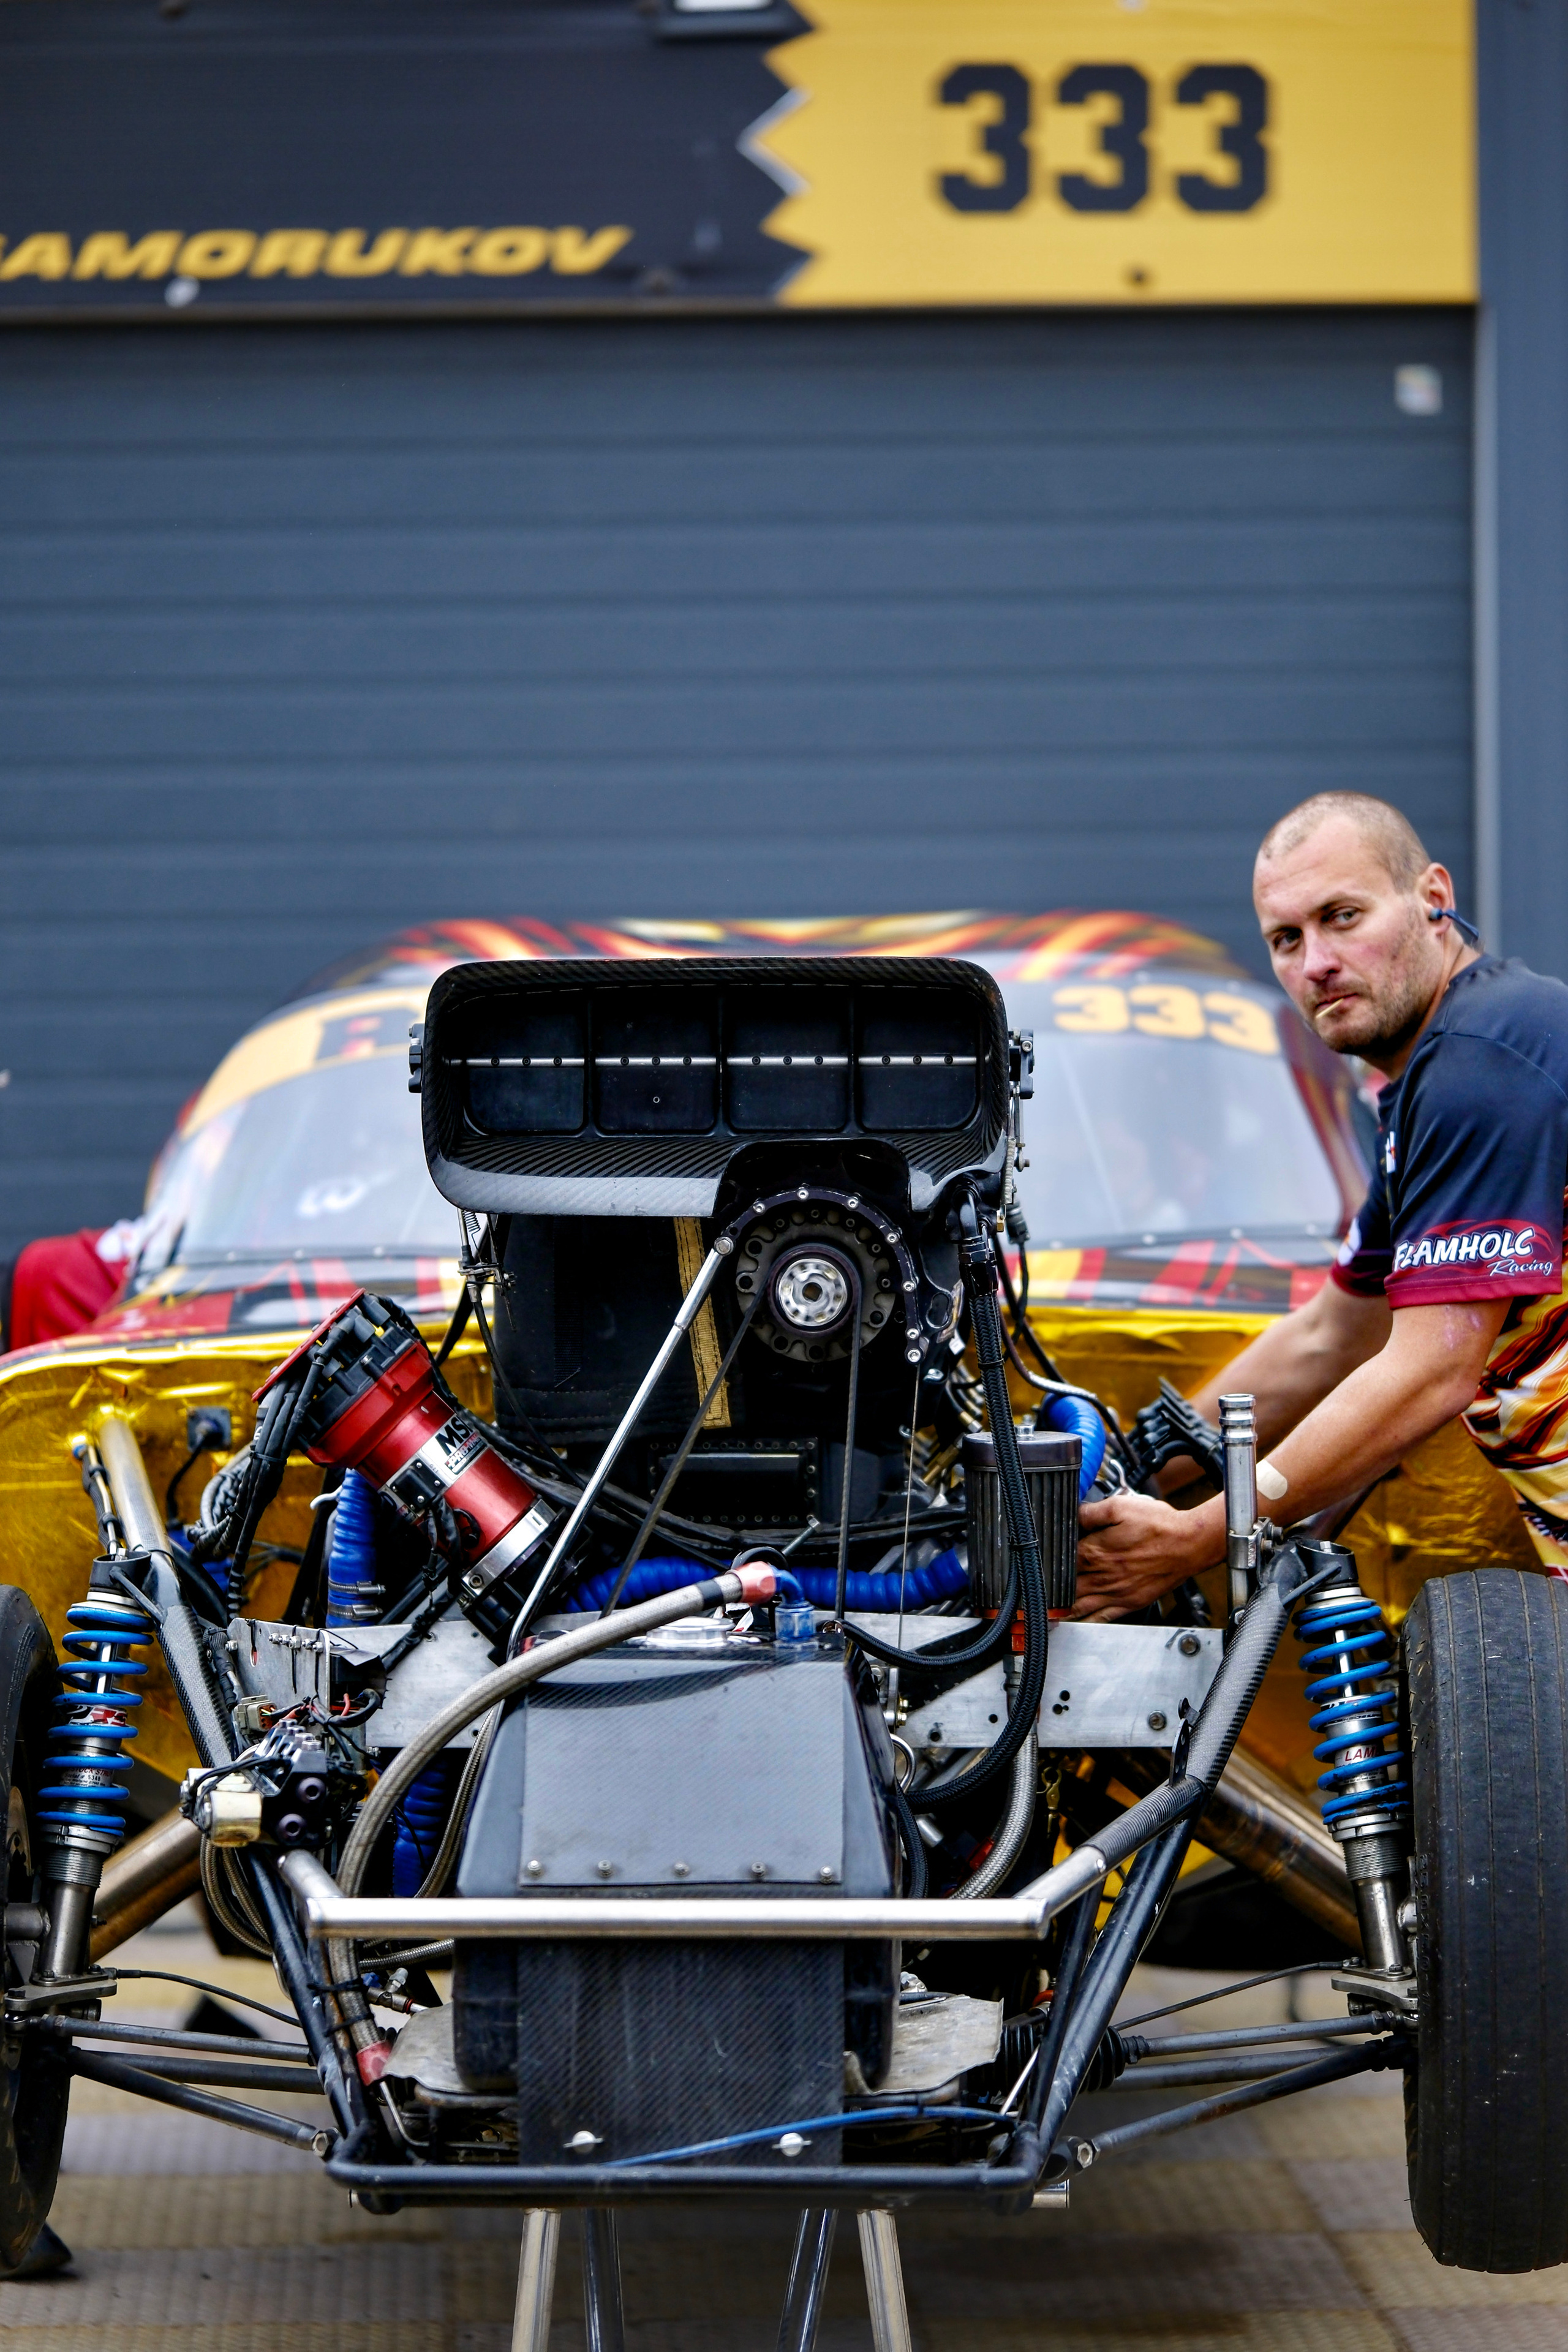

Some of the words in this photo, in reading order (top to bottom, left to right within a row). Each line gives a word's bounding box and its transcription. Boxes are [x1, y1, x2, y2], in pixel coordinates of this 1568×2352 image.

[933, 61, 1275, 214] 333
[0, 227, 633, 280] AMORUKOV
[1052, 985, 1280, 1055] 333
[1393, 1227, 1536, 1272] FLAMHOLC
[1487, 1259, 1553, 1276] Racing
[1344, 1745, 1378, 1762] LAM
